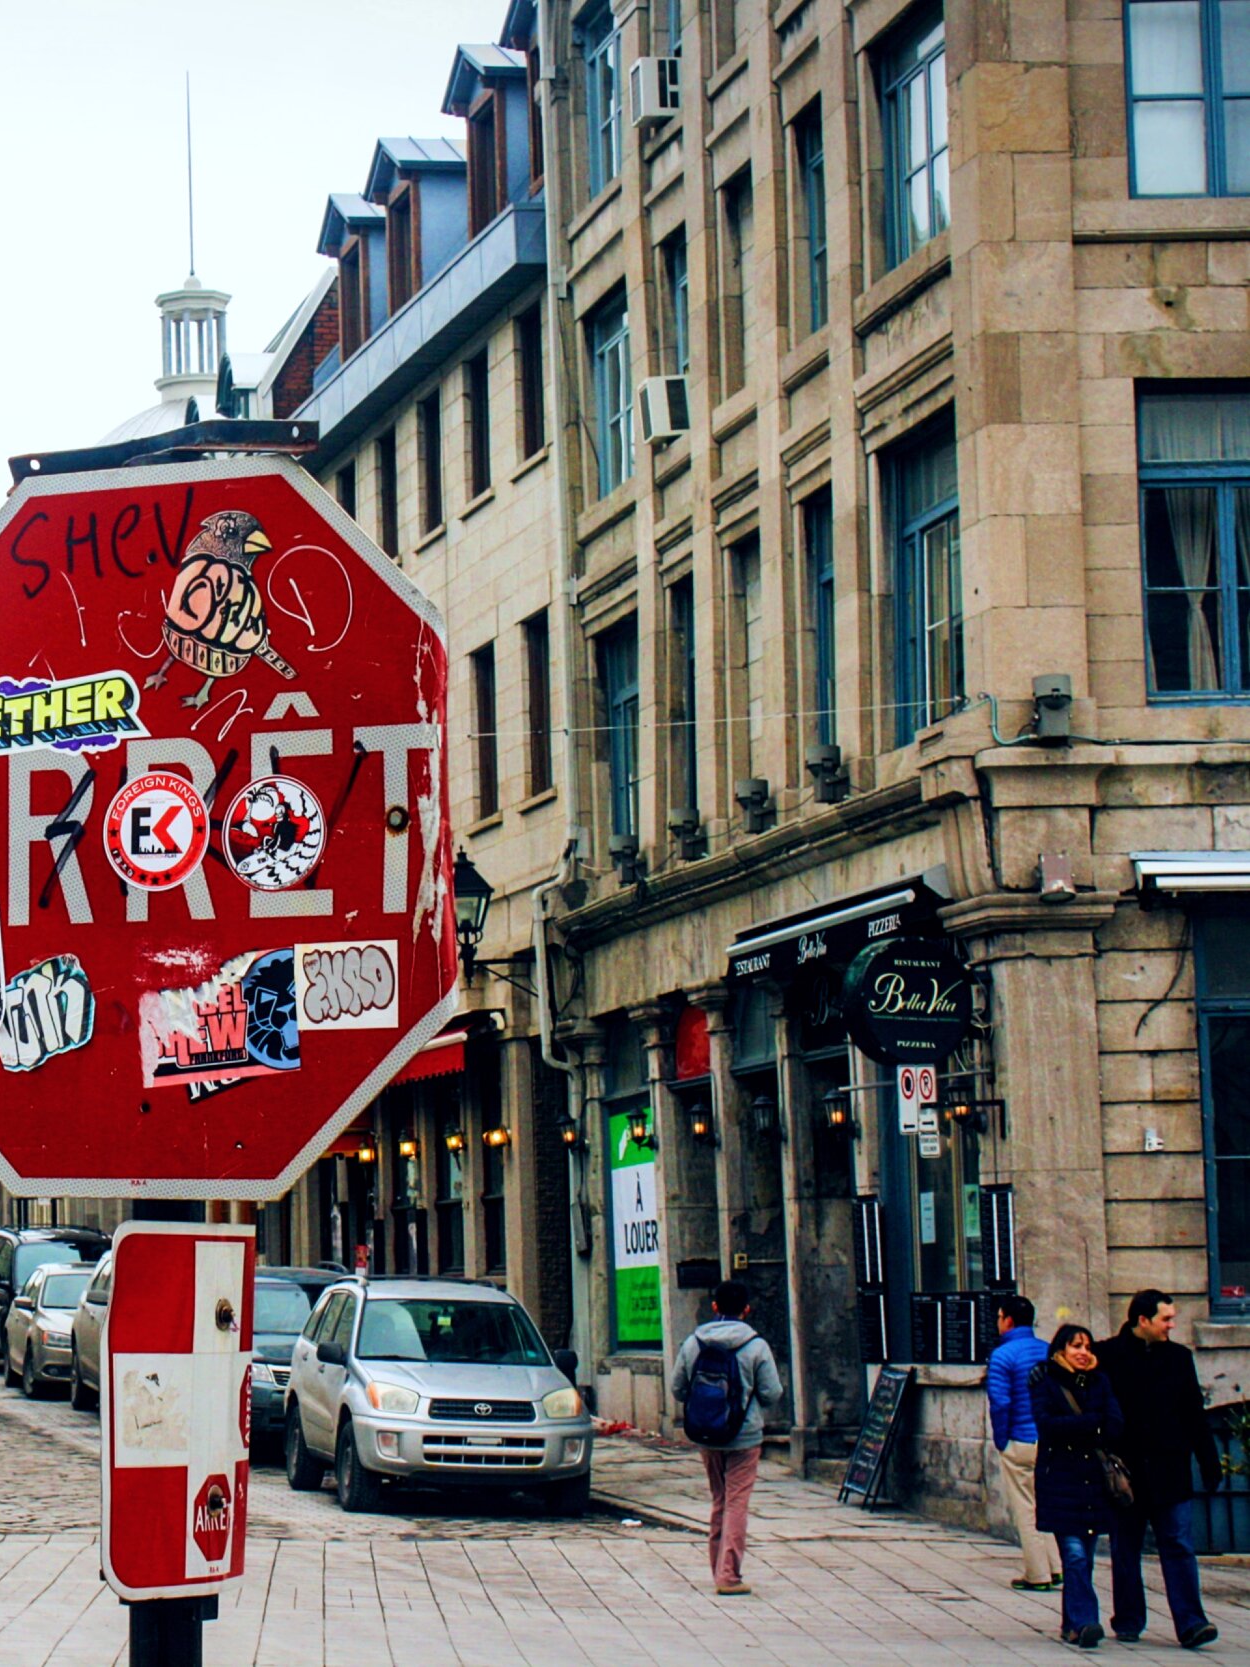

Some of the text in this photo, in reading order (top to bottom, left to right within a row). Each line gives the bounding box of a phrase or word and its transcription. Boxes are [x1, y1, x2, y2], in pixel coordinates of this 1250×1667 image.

[111, 776, 203, 820] FOREIGN KINGS
[894, 959, 941, 968] RESTAURANT
[868, 972, 926, 1013] Bella
[926, 978, 963, 1014] Vita
[897, 1040, 936, 1049] PIZZERIA
[635, 1171, 644, 1213] À
[624, 1219, 659, 1255] LOUER
